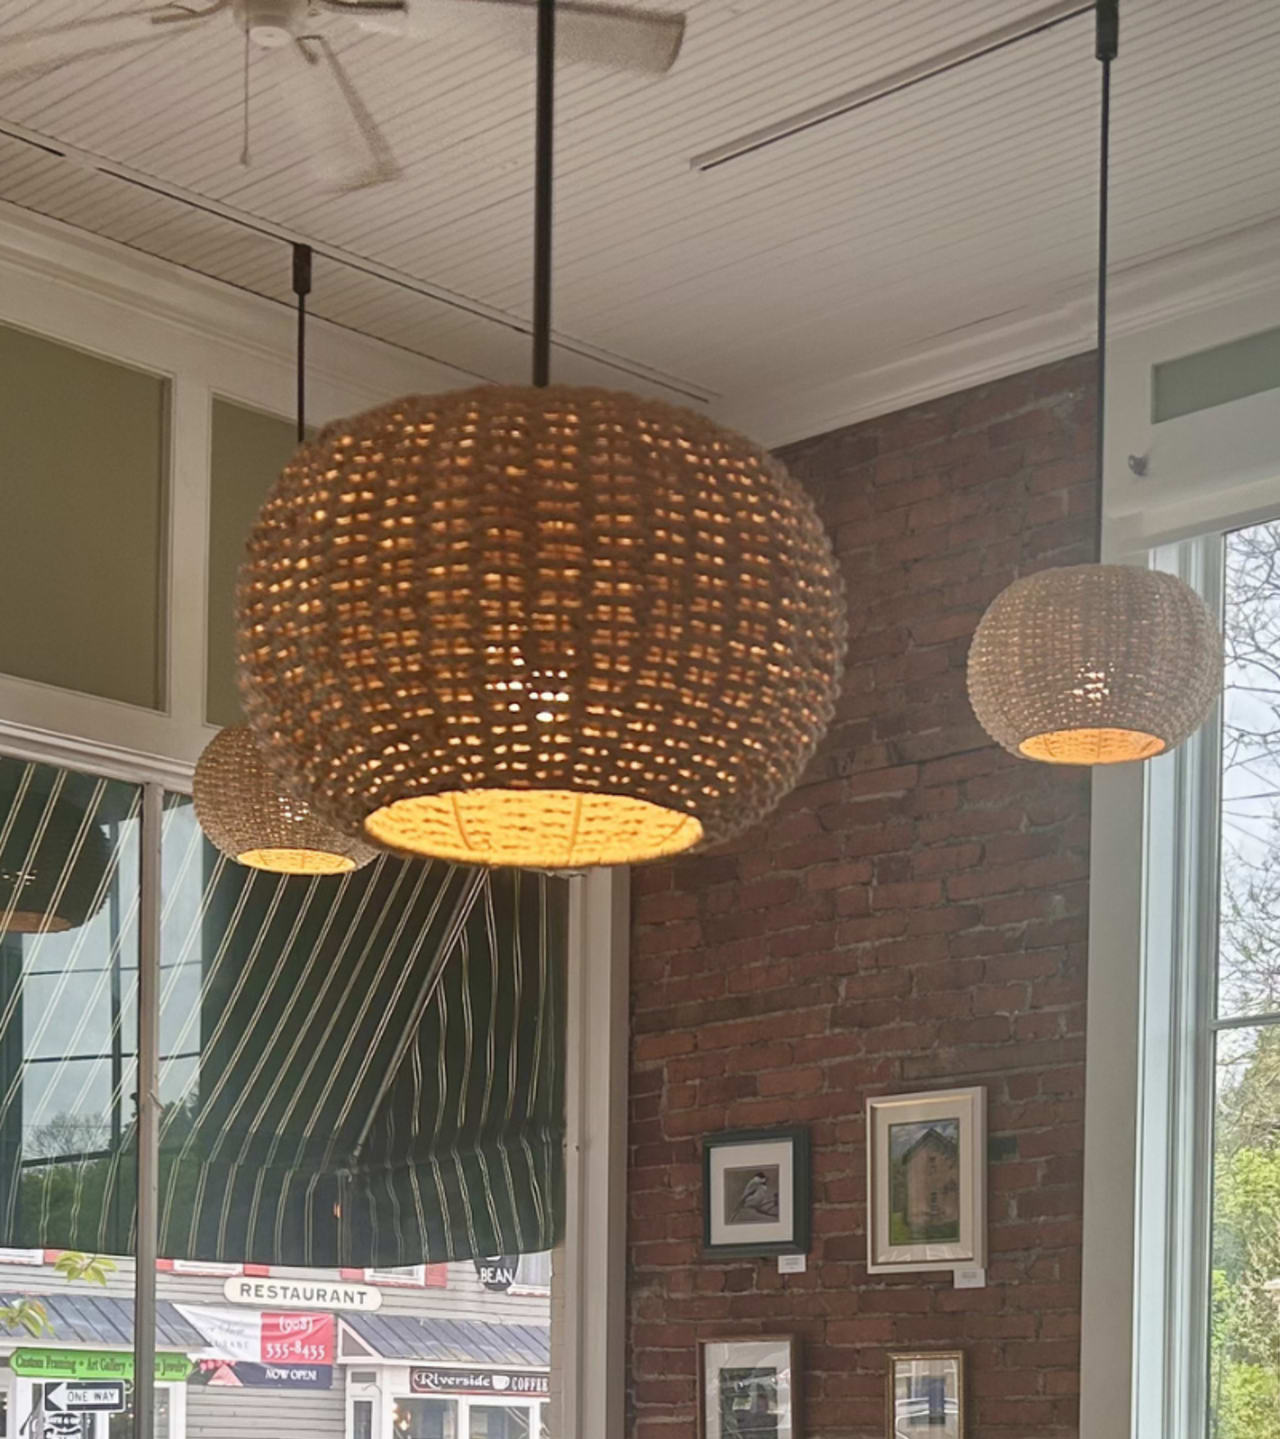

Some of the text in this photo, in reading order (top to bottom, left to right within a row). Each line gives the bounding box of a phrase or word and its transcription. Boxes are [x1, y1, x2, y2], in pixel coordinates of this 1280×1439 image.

[480, 1267, 512, 1283] BEAN
[240, 1283, 367, 1305] RESTAURANT
[279, 1316, 313, 1333] (908)
[265, 1368, 289, 1379] NOW
[415, 1373, 548, 1392] Riverside COFFEE
[67, 1391, 115, 1402] ONE WAY
